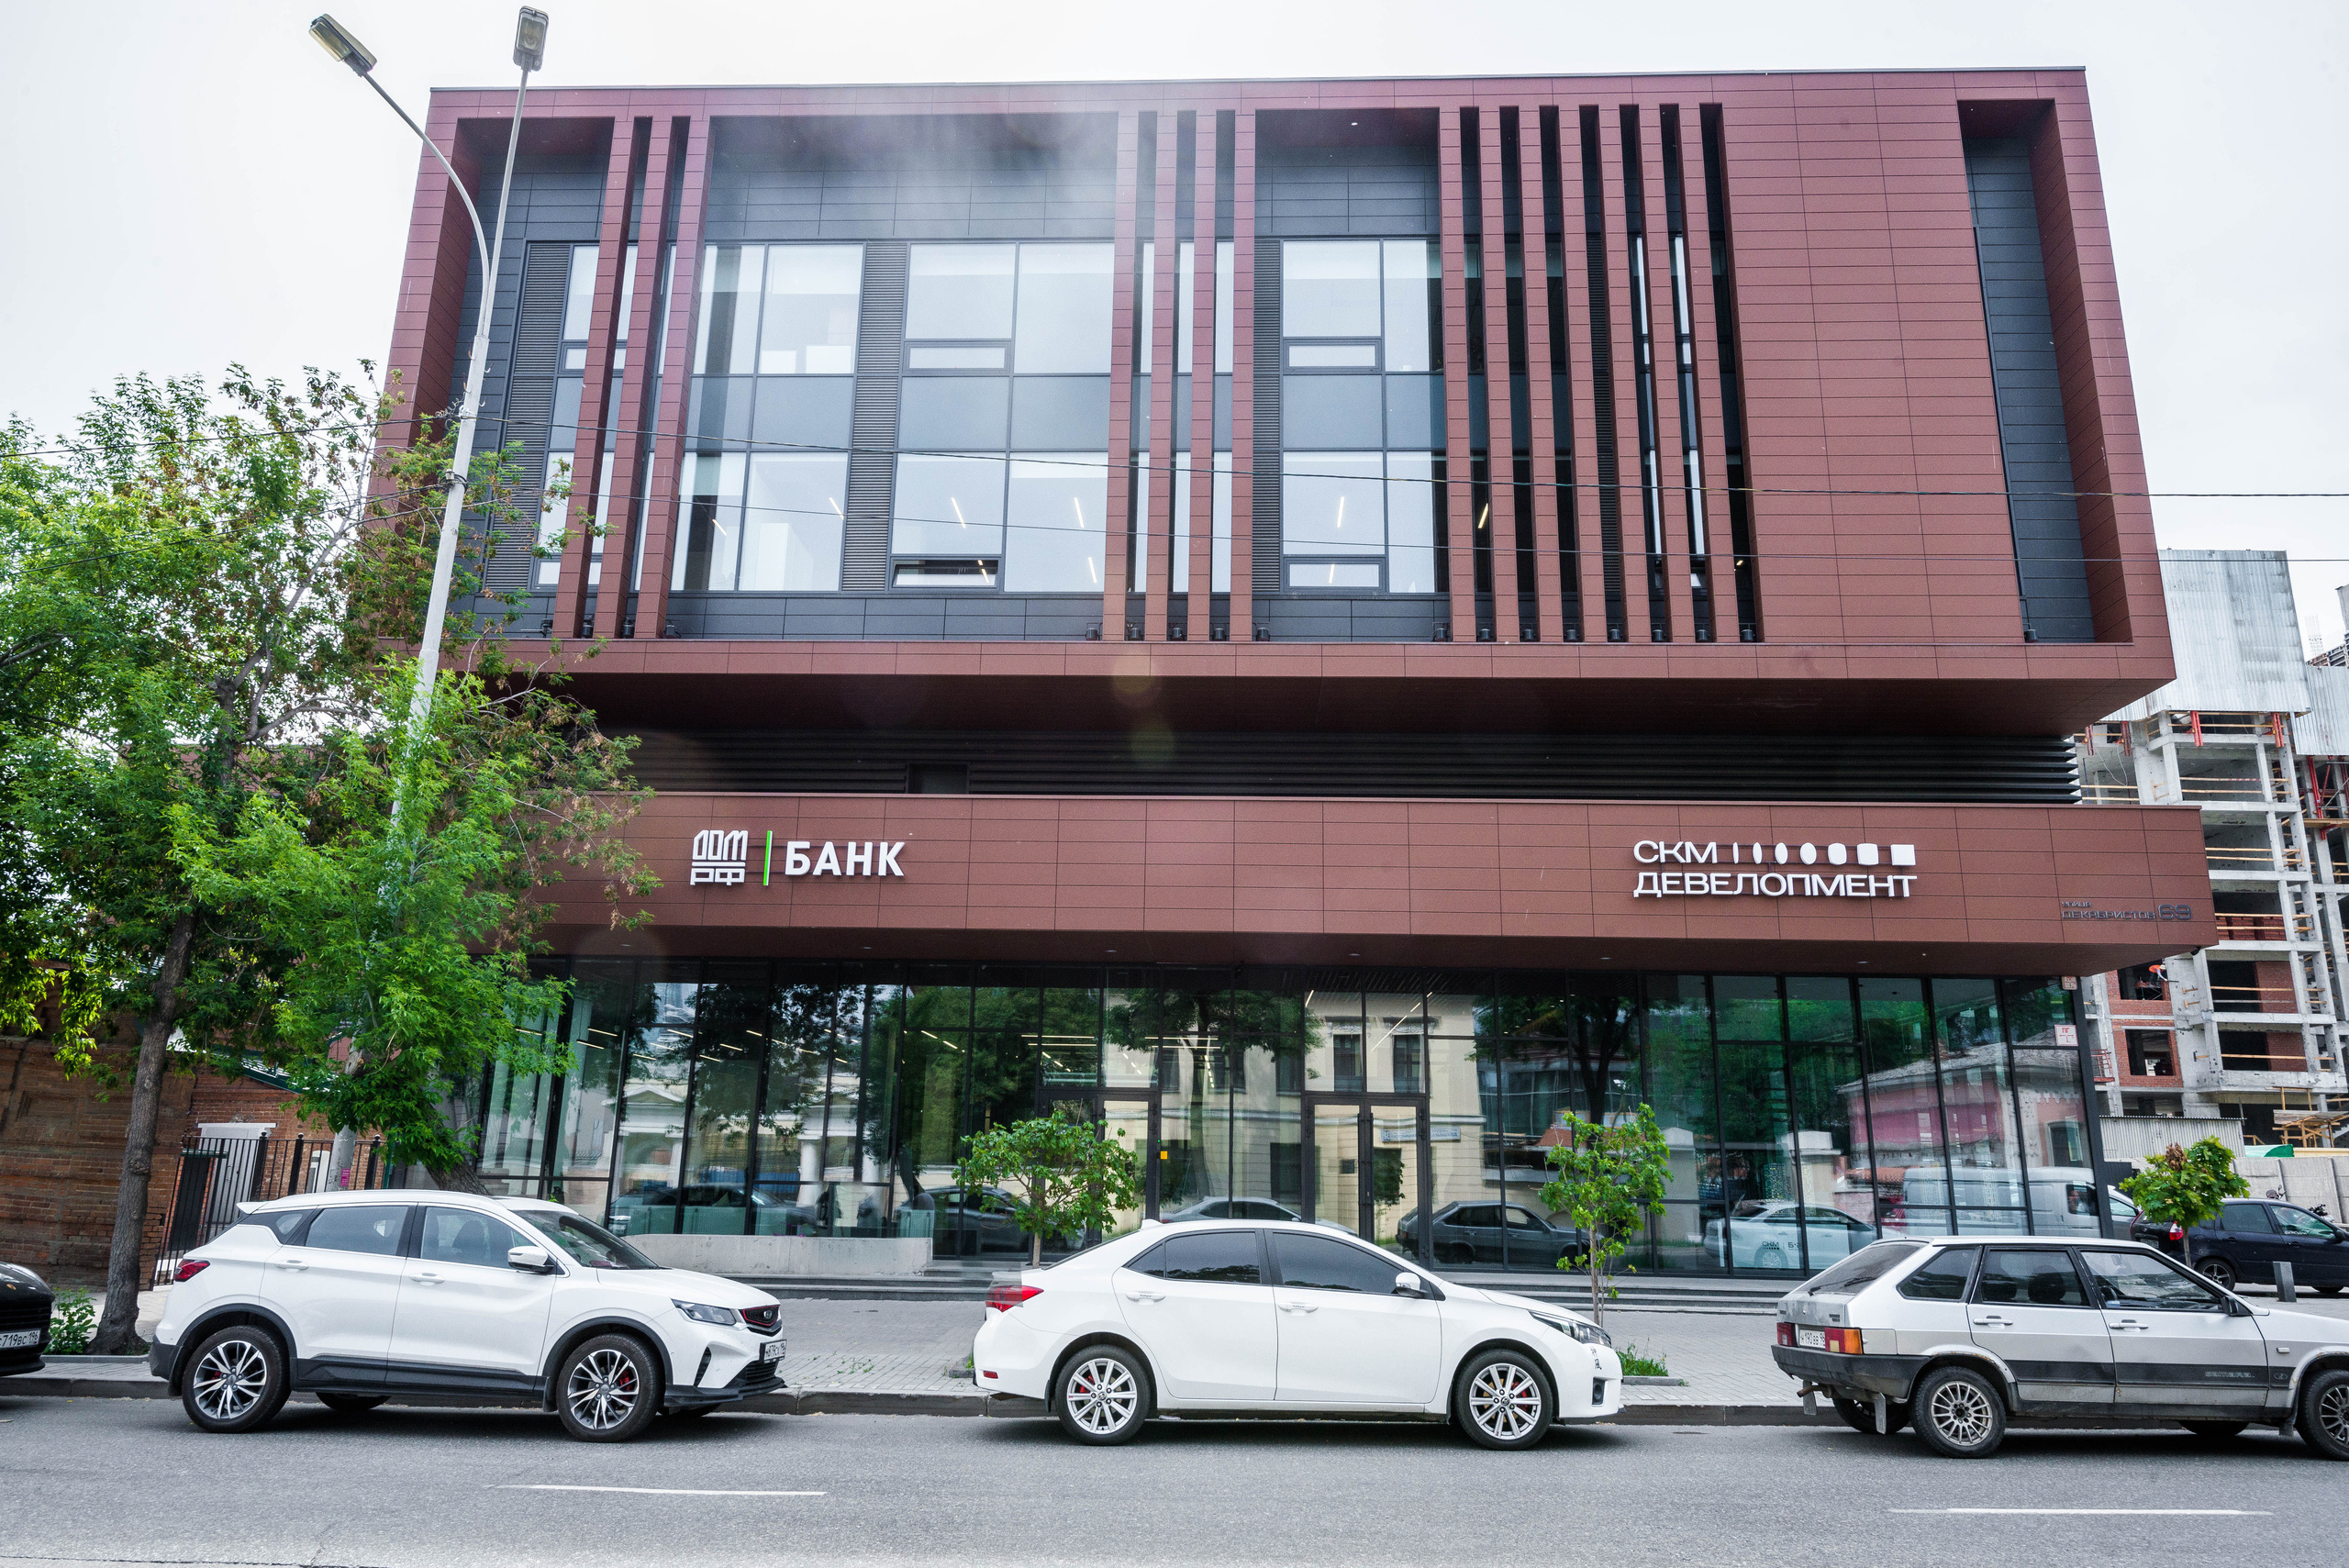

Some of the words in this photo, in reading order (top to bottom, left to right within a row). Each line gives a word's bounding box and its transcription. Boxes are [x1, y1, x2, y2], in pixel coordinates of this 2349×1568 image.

[692, 829, 749, 861] ДОМ
[1633, 840, 1718, 864] СКМ
[785, 841, 906, 877] БАНК
[690, 868, 745, 886] РФ
[1633, 873, 1918, 898] ДЕВЕЛОПМЕНТ
[2062, 910, 2156, 919] ДЕКАБРИСТОВ
[2158, 904, 2192, 920] 69
